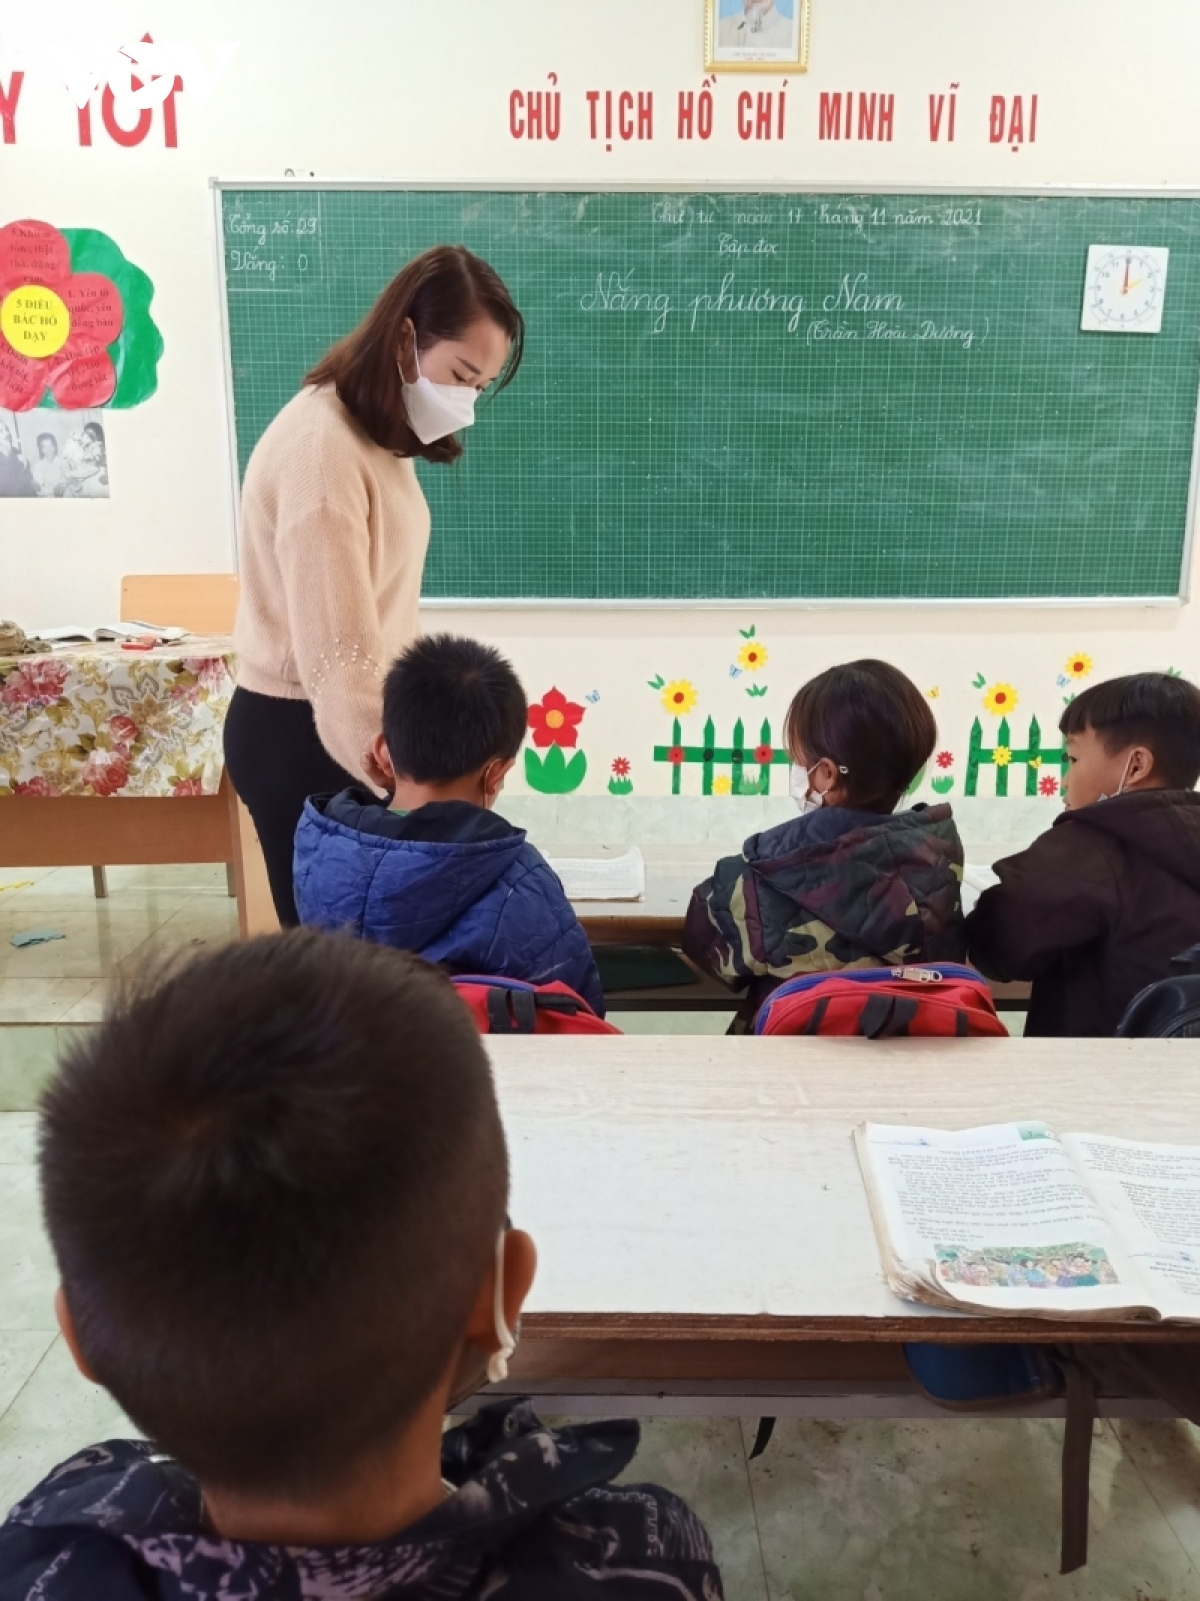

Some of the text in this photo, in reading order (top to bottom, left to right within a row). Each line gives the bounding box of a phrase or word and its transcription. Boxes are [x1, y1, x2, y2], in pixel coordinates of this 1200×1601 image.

[509, 71, 1038, 152] CHỦ TỊCH HỒ CHÍ MINH VĨ ĐẠI
[869, 207, 887, 227] 11
[893, 208, 935, 225] năm
[940, 207, 983, 226] 2021
[297, 253, 308, 271] 0
[16, 298, 22, 308] 5
[580, 268, 904, 334] Nắng phương Nam
[23, 330, 47, 343] DẠY
